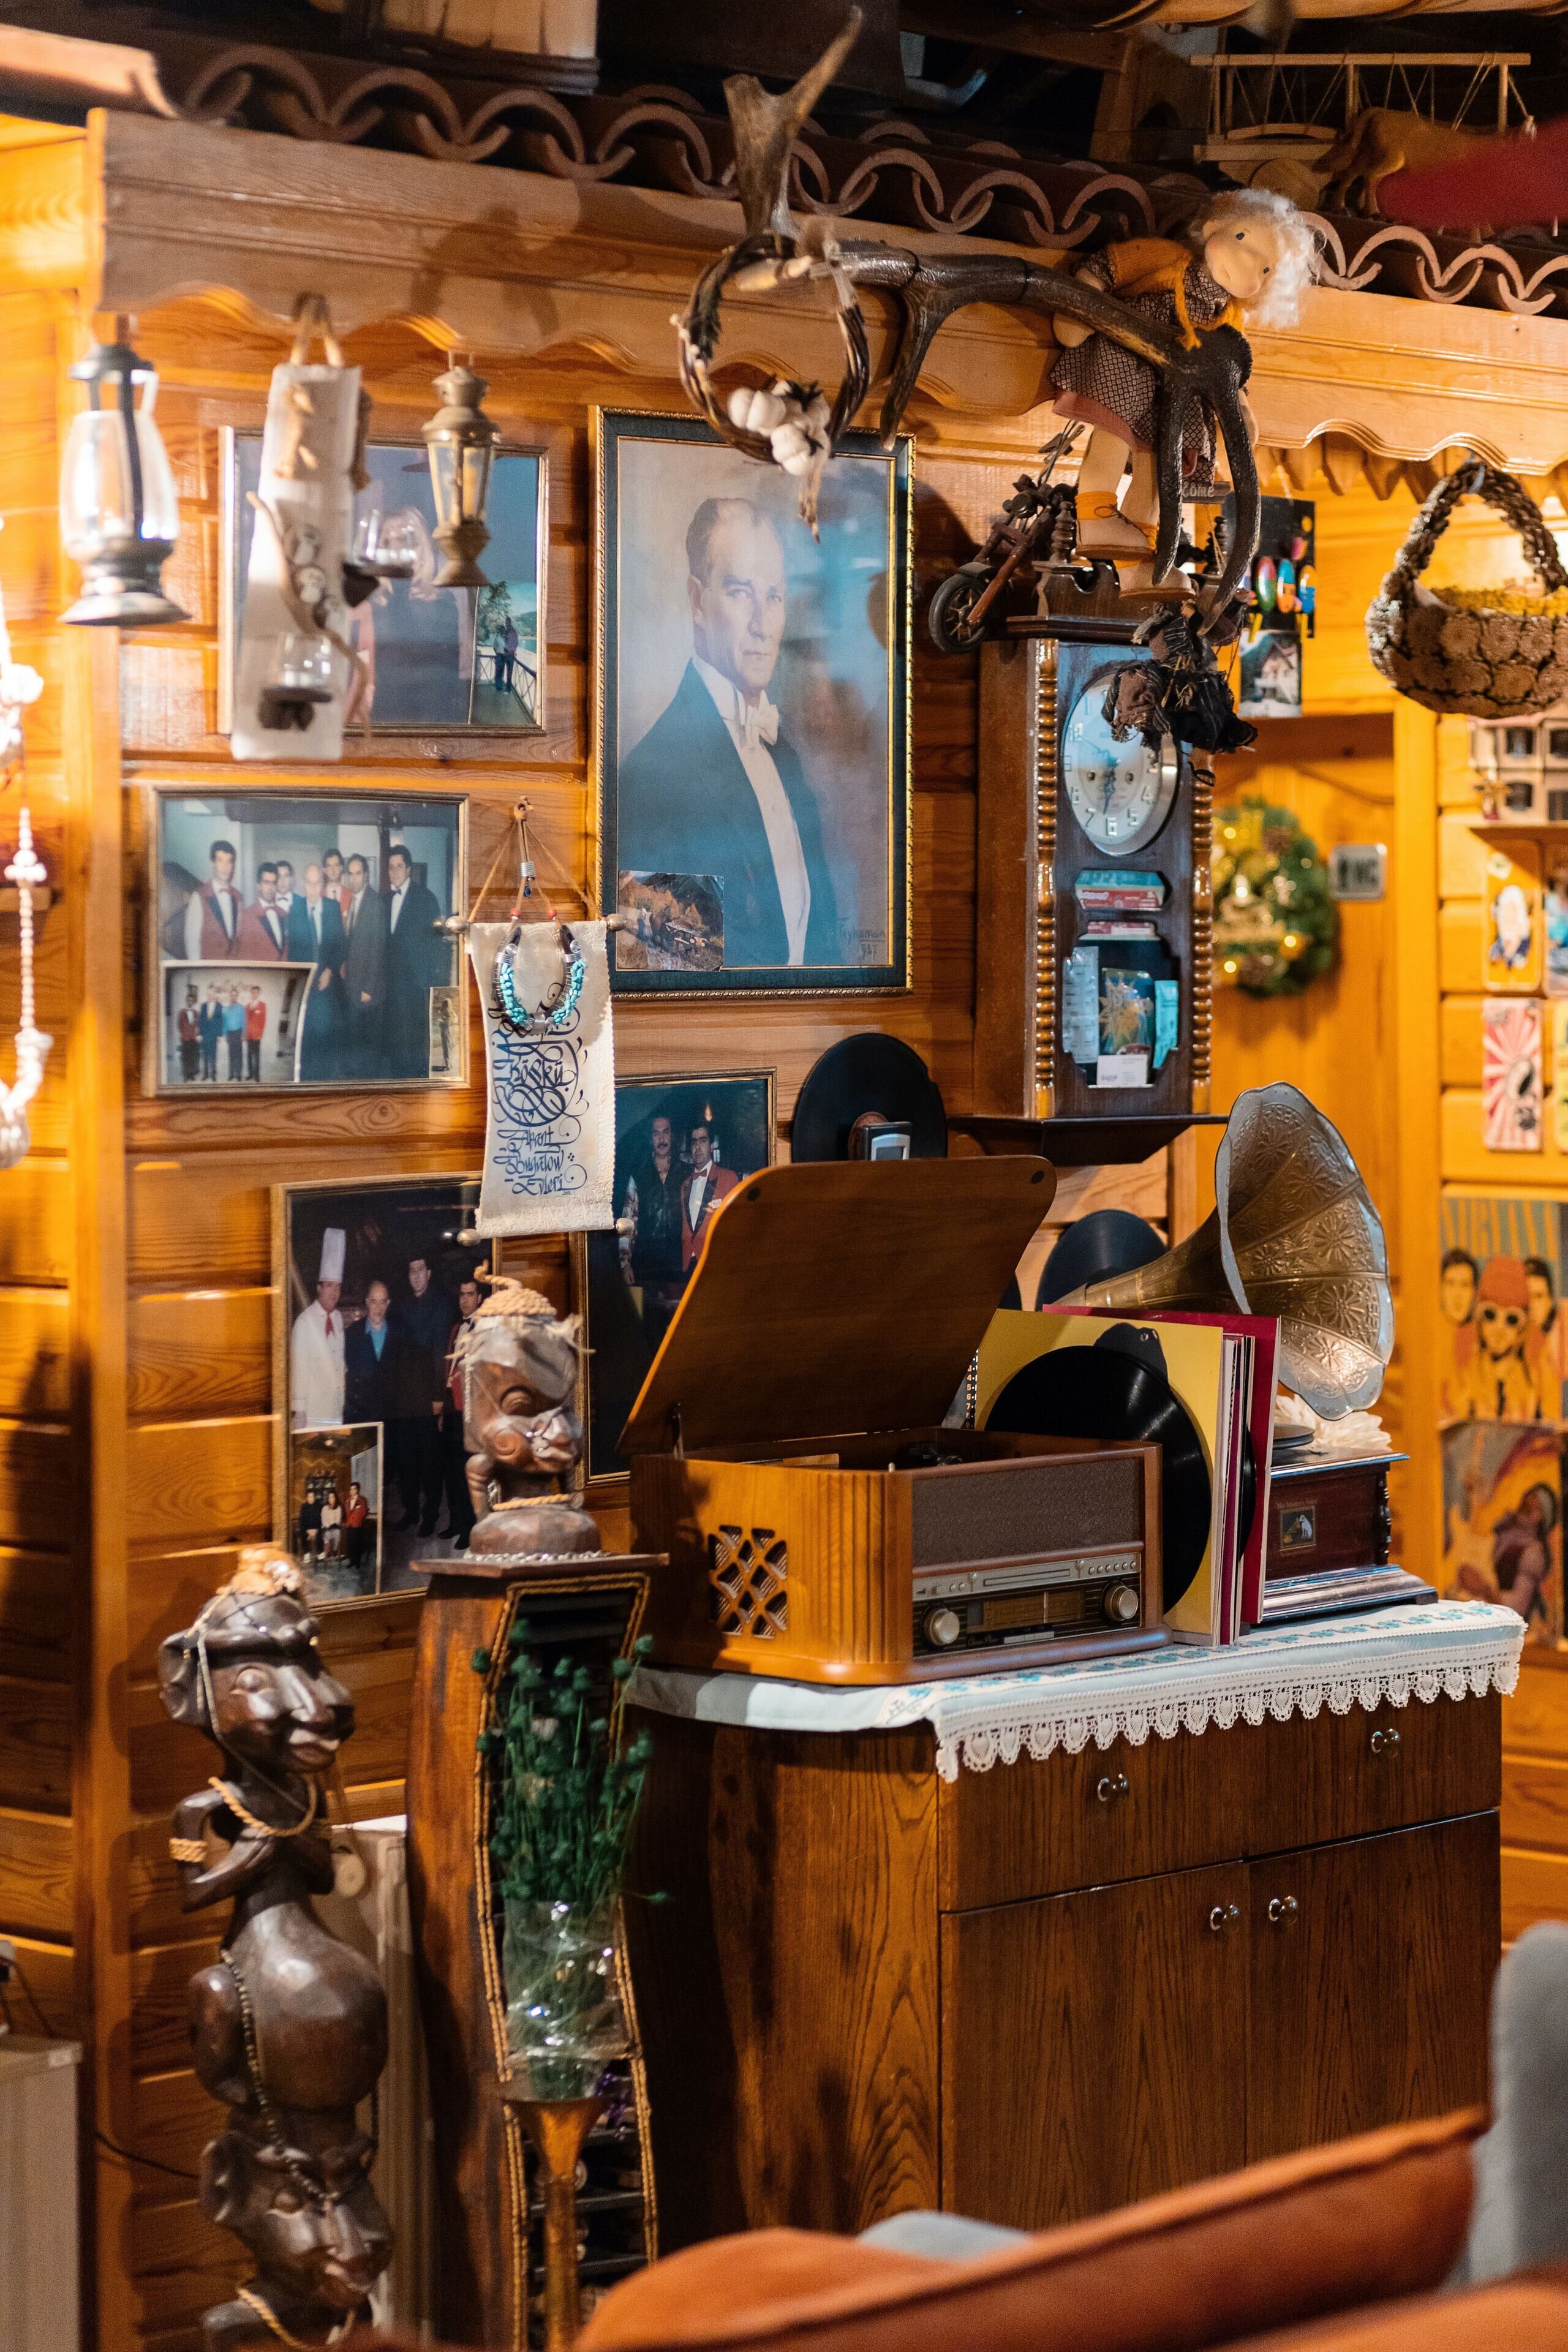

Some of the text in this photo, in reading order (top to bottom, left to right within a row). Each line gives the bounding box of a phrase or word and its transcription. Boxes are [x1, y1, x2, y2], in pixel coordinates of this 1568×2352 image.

[1085, 808, 1096, 827] 7
[1106, 816, 1118, 836] 6
[1128, 808, 1139, 826] 5
[511, 1174, 565, 1196] Evleri
